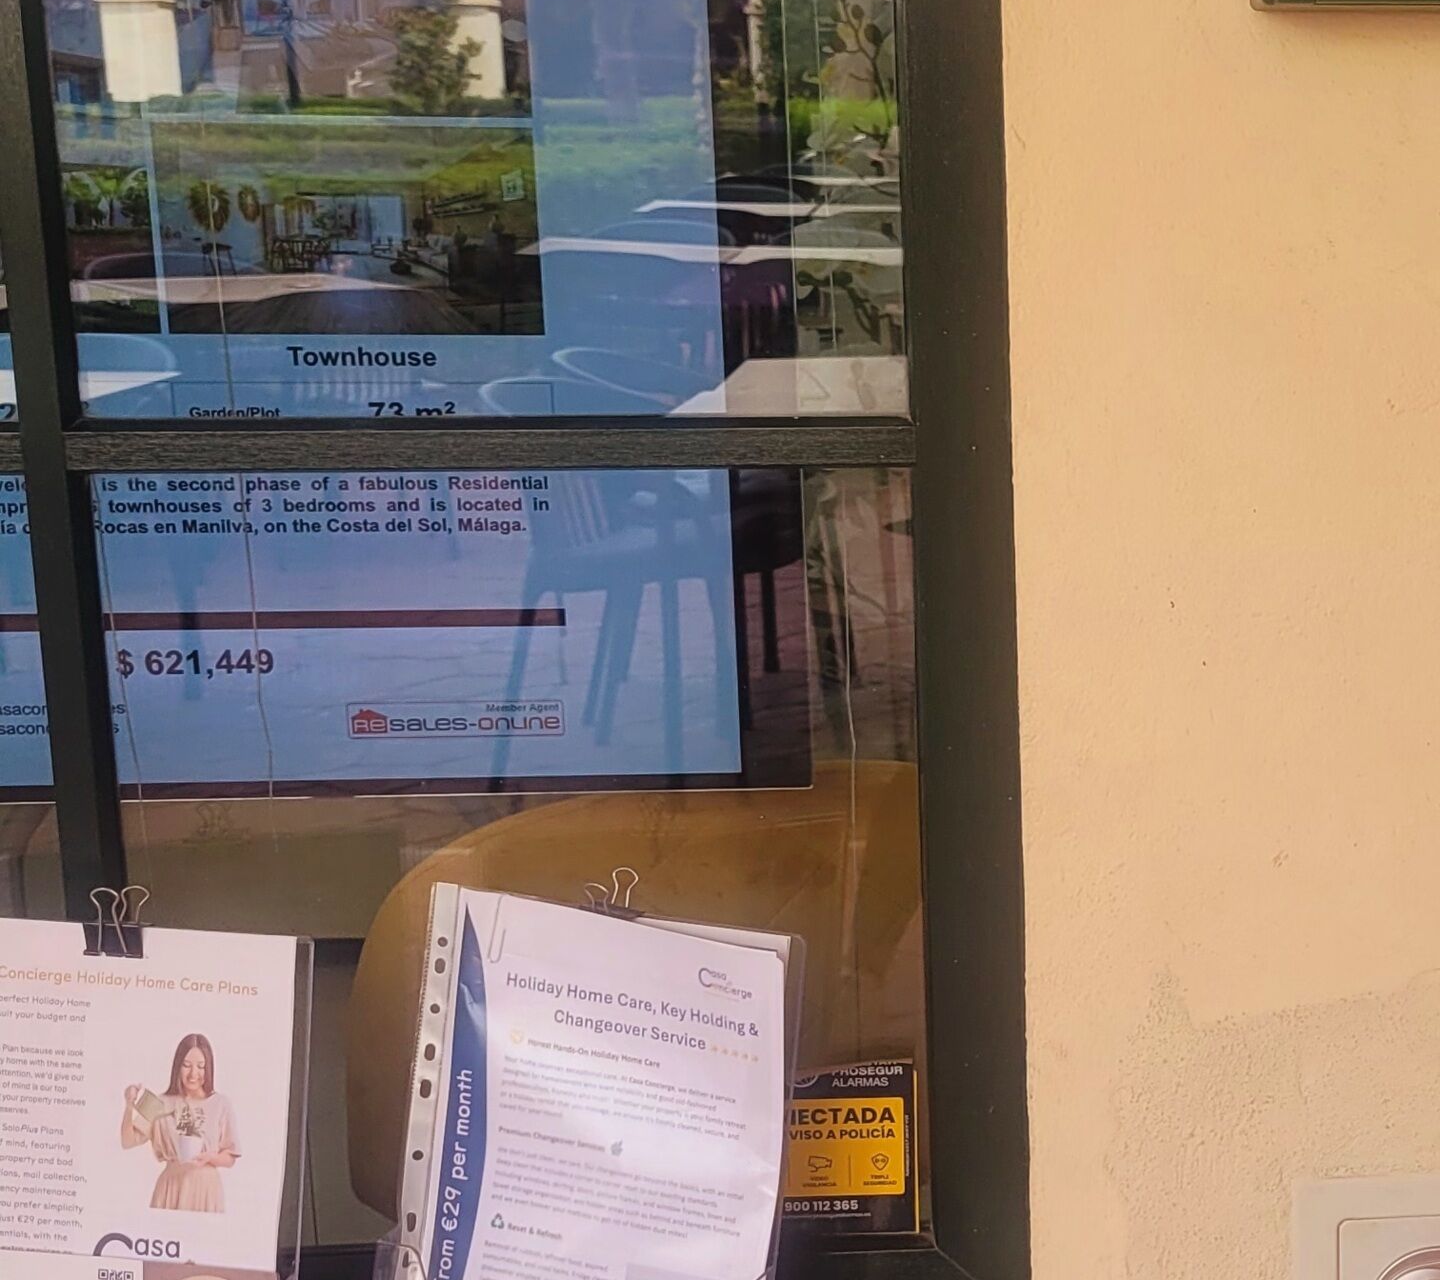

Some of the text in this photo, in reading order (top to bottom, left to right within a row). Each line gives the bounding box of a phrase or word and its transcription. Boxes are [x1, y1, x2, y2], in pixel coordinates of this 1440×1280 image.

[287, 346, 437, 367] Townhouse
[102, 476, 549, 495] is the second phase of a fabulous Residential
[108, 498, 222, 513] townhouses
[233, 498, 251, 513] of
[262, 499, 273, 513] 3
[284, 498, 376, 513] bedrooms
[386, 498, 420, 512] and
[431, 498, 447, 512] is
[457, 497, 523, 512] located
[533, 497, 550, 512] in
[154, 523, 177, 534] en
[183, 519, 258, 536] Manilva,
[264, 522, 287, 534] on
[292, 519, 321, 533] the
[327, 518, 380, 533] Costa
[385, 518, 412, 533] del
[418, 518, 452, 536] Sol,
[458, 517, 527, 535] Málaga.
[115, 648, 274, 680] $ 621,449
[486, 703, 559, 713] Member Agent
[0, 966, 259, 996] Concierge Holiday Home Care Plans
[32, 995, 65, 1008] Holiday
[67, 999, 91, 1009] Home
[506, 972, 760, 1037] Holiday Home Care, Key Holding &
[36, 1011, 67, 1023] budget
[554, 1010, 707, 1051] Changeover Service
[832, 1077, 889, 1088] ALARMAS
[456, 1069, 473, 1135] month
[826, 1129, 837, 1140] A
[839, 1125, 896, 1139] POLICÍA
[30, 1140, 71, 1153] featuring
[448, 1140, 469, 1181] per
[22, 1185, 77, 1197] maintenance
[440, 1185, 462, 1232] €29
[784, 1200, 859, 1212] 900 112 365
